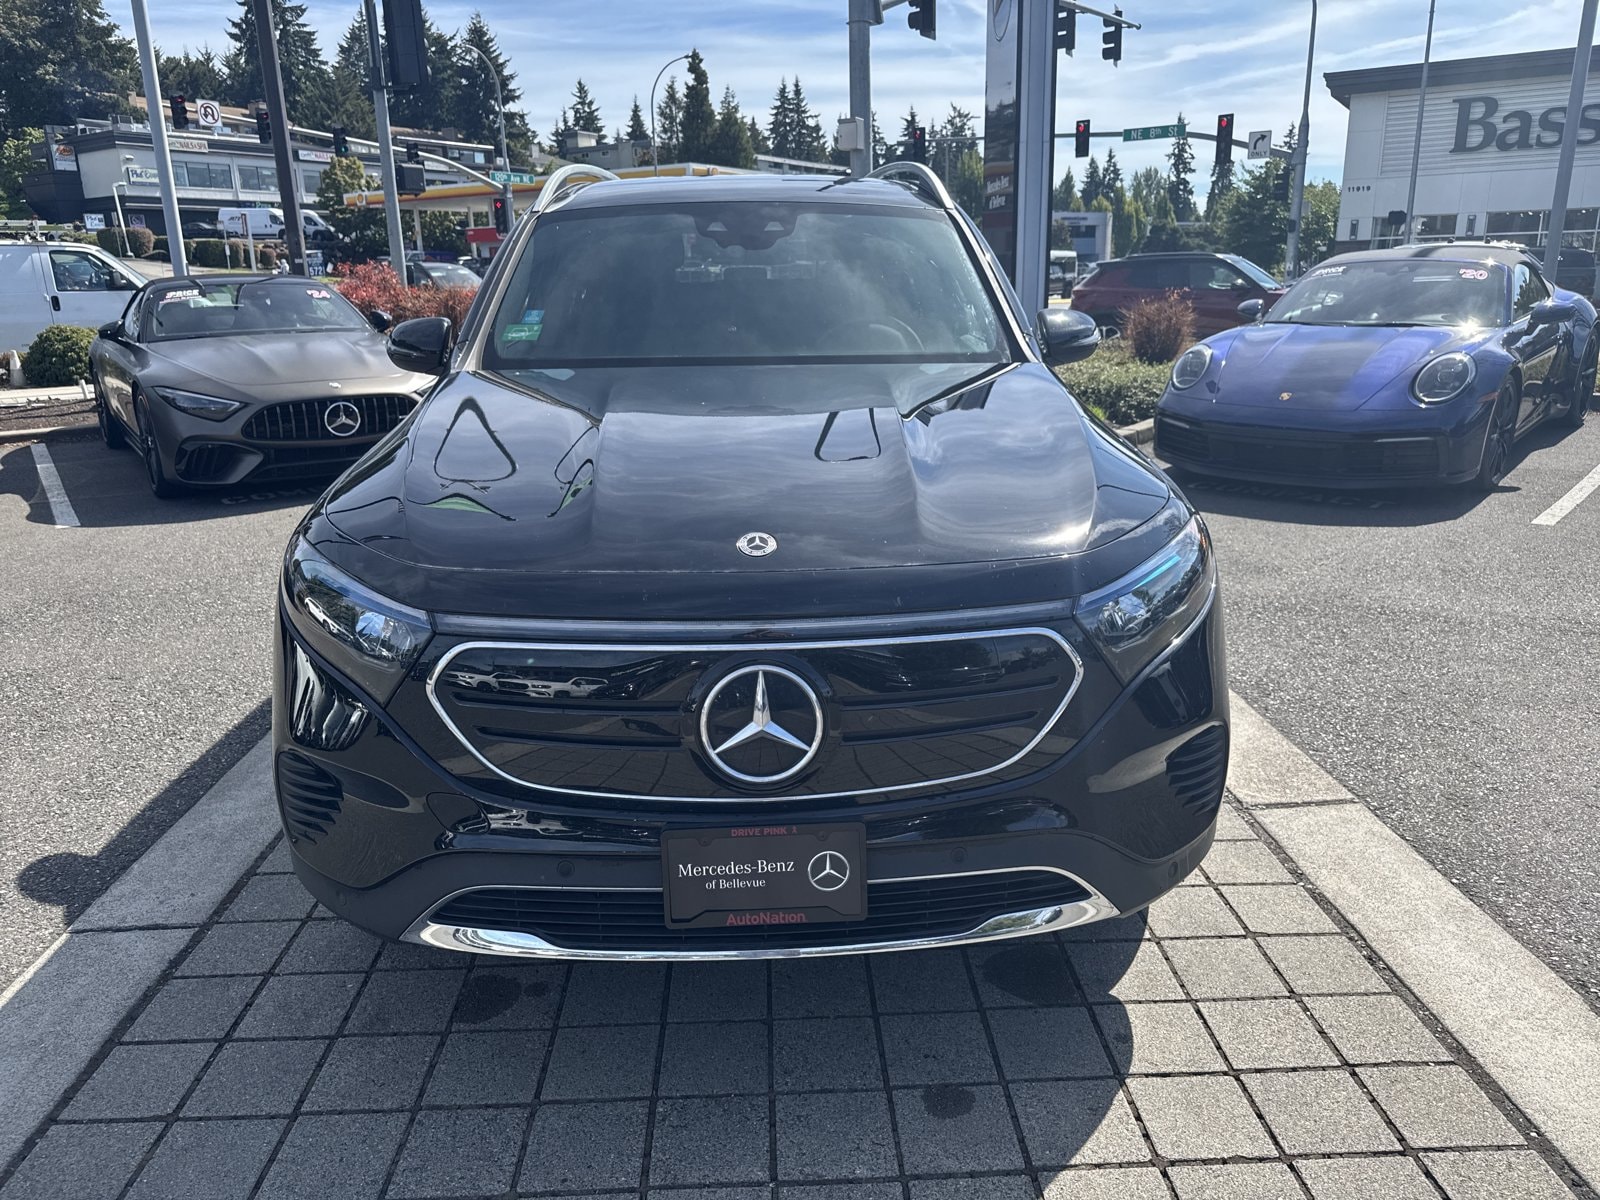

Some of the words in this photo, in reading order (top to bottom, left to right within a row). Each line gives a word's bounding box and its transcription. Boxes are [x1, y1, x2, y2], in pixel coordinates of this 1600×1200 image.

[1449, 96, 1600, 153] Bass
[1131, 129, 1143, 140] NE
[1150, 127, 1161, 138] 8th
[1168, 126, 1178, 137] St
[494, 173, 507, 181] 120th
[511, 174, 520, 182] Ave
[731, 828, 761, 837] DRIVE
[764, 827, 787, 836] PINK
[678, 860, 795, 877] Mercedes-Benz
[705, 879, 717, 890] of
[719, 878, 766, 889] Bellevue
[726, 911, 806, 927] AutoNation
